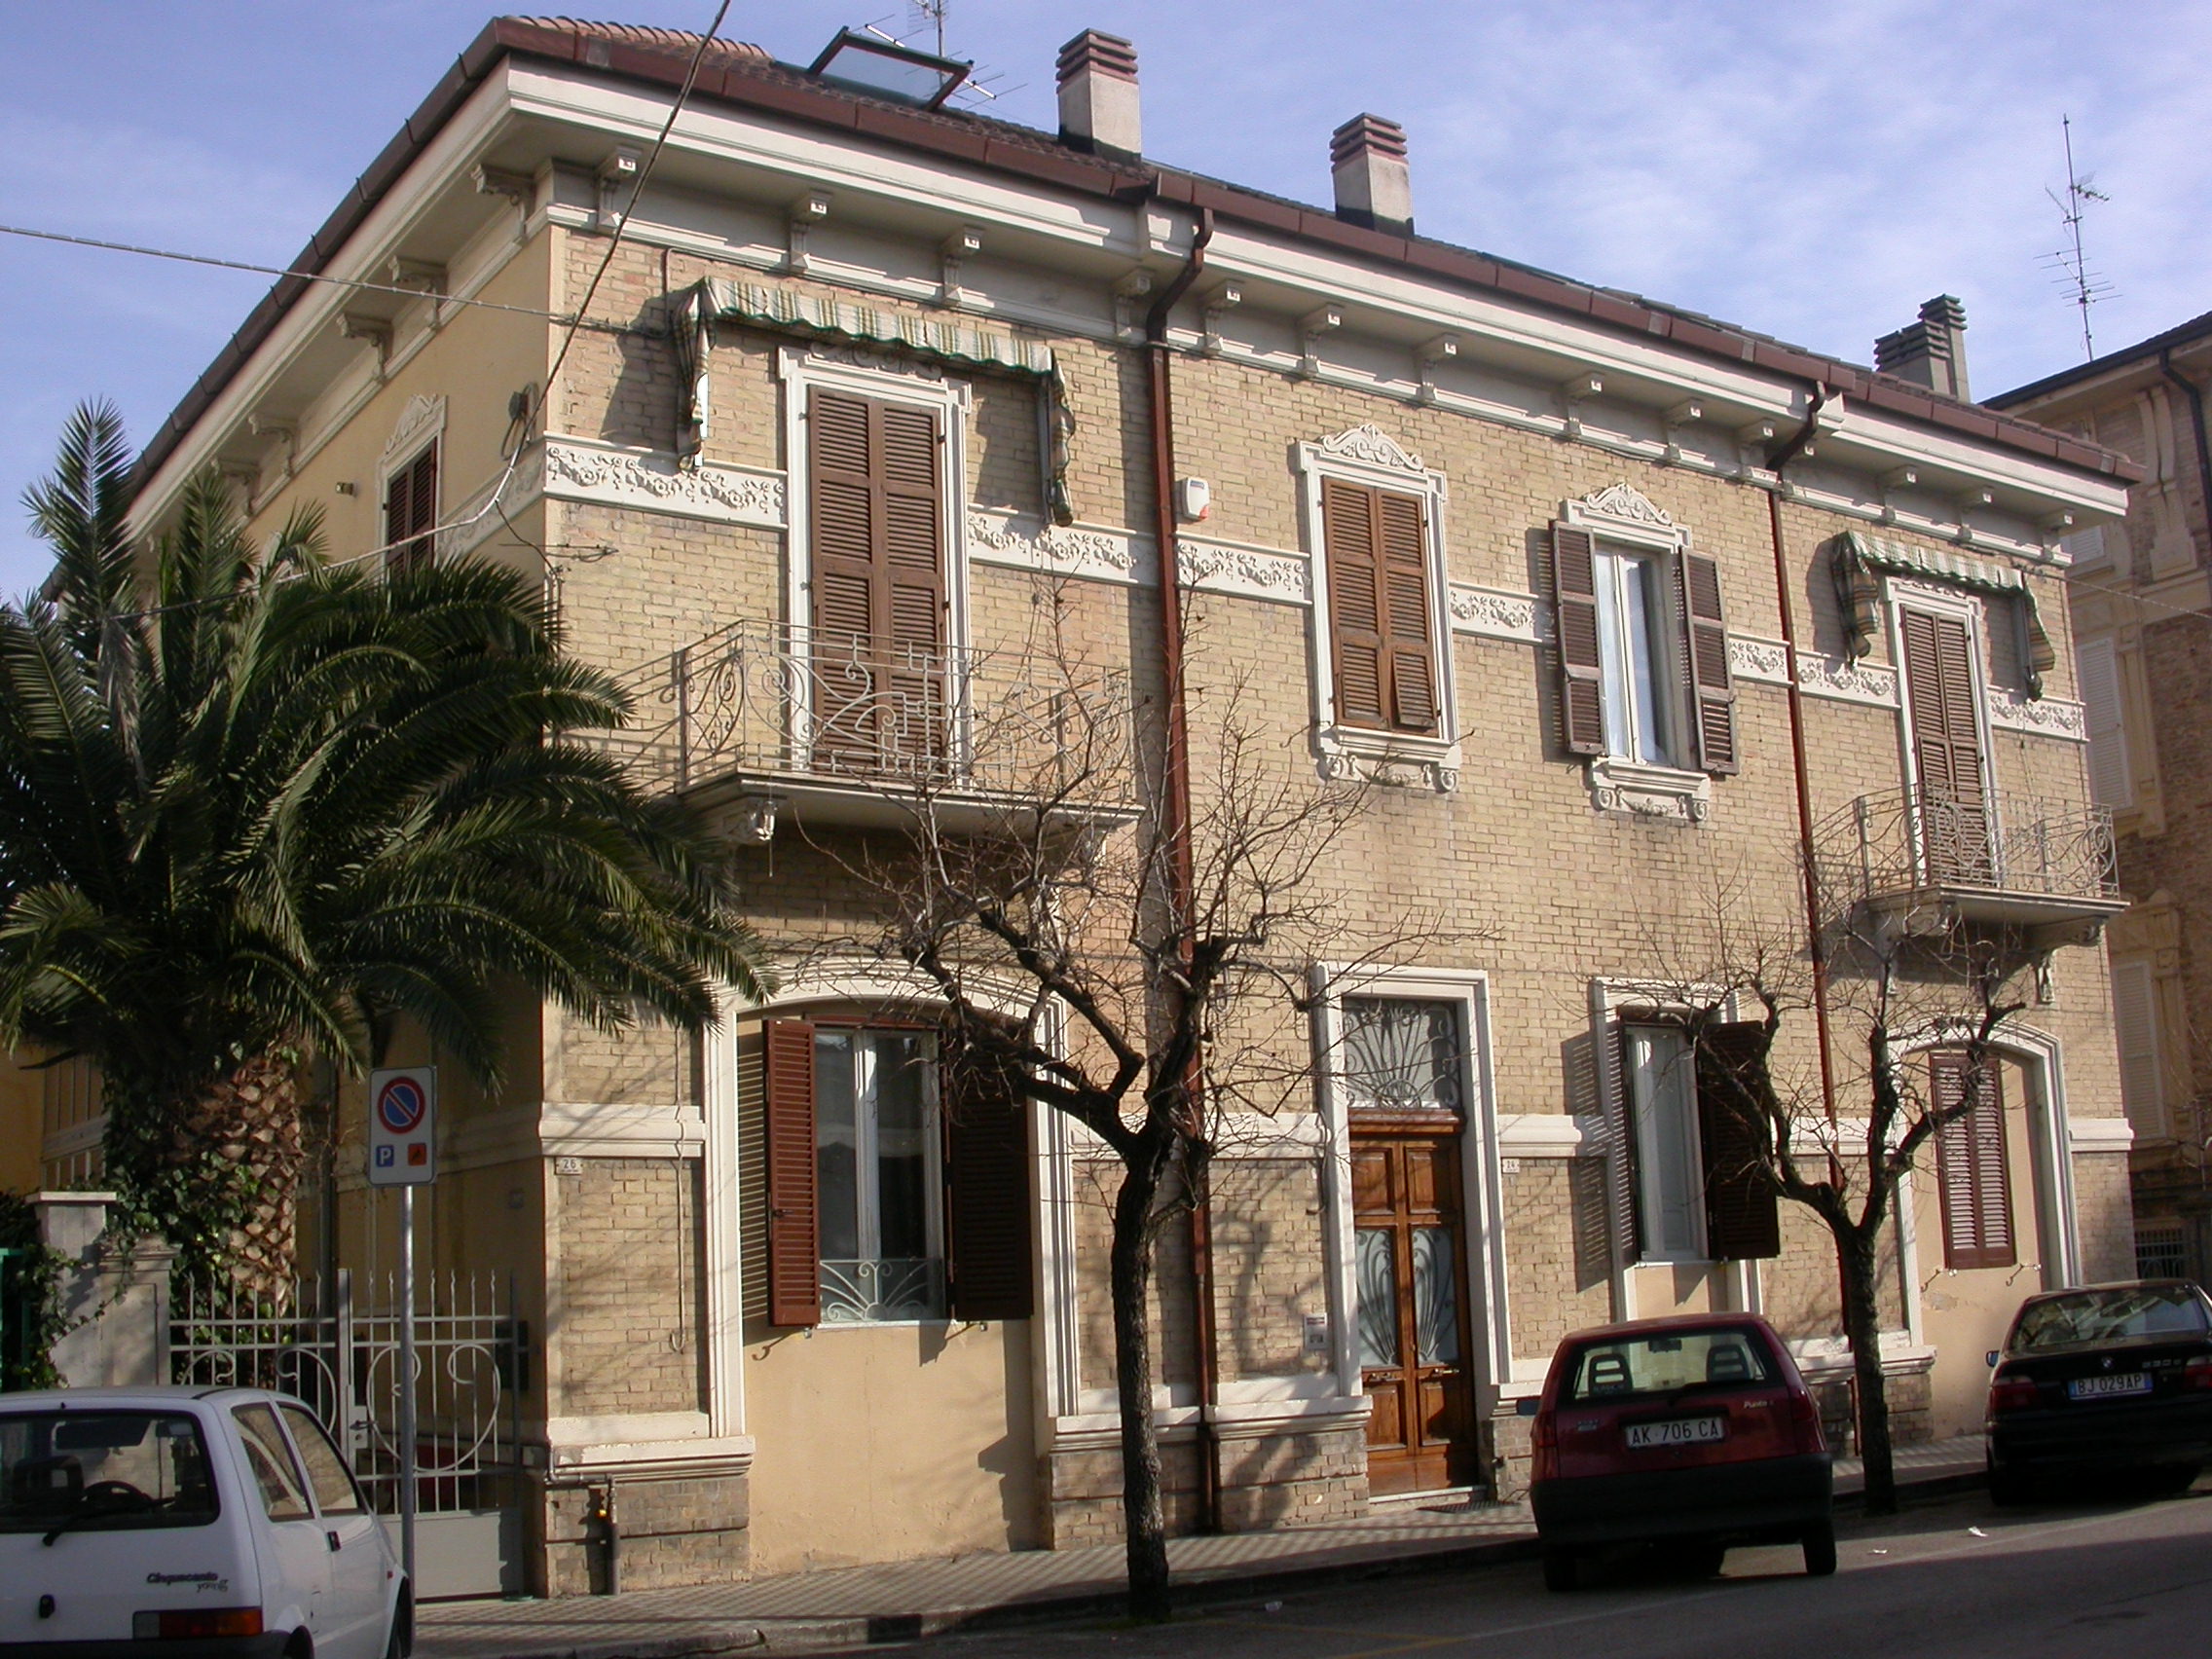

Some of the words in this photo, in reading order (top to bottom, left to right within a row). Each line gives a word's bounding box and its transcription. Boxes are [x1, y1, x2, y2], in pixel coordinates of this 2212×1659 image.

[379, 1147, 391, 1165] P
[563, 1159, 576, 1169] 26
[2078, 1378, 2095, 1394] BJ
[2099, 1374, 2142, 1391] 029AP
[1744, 1400, 1768, 1410] Punto
[1632, 1426, 1651, 1446] AK
[1661, 1421, 1692, 1442] 706
[1698, 1419, 1719, 1438] CA
